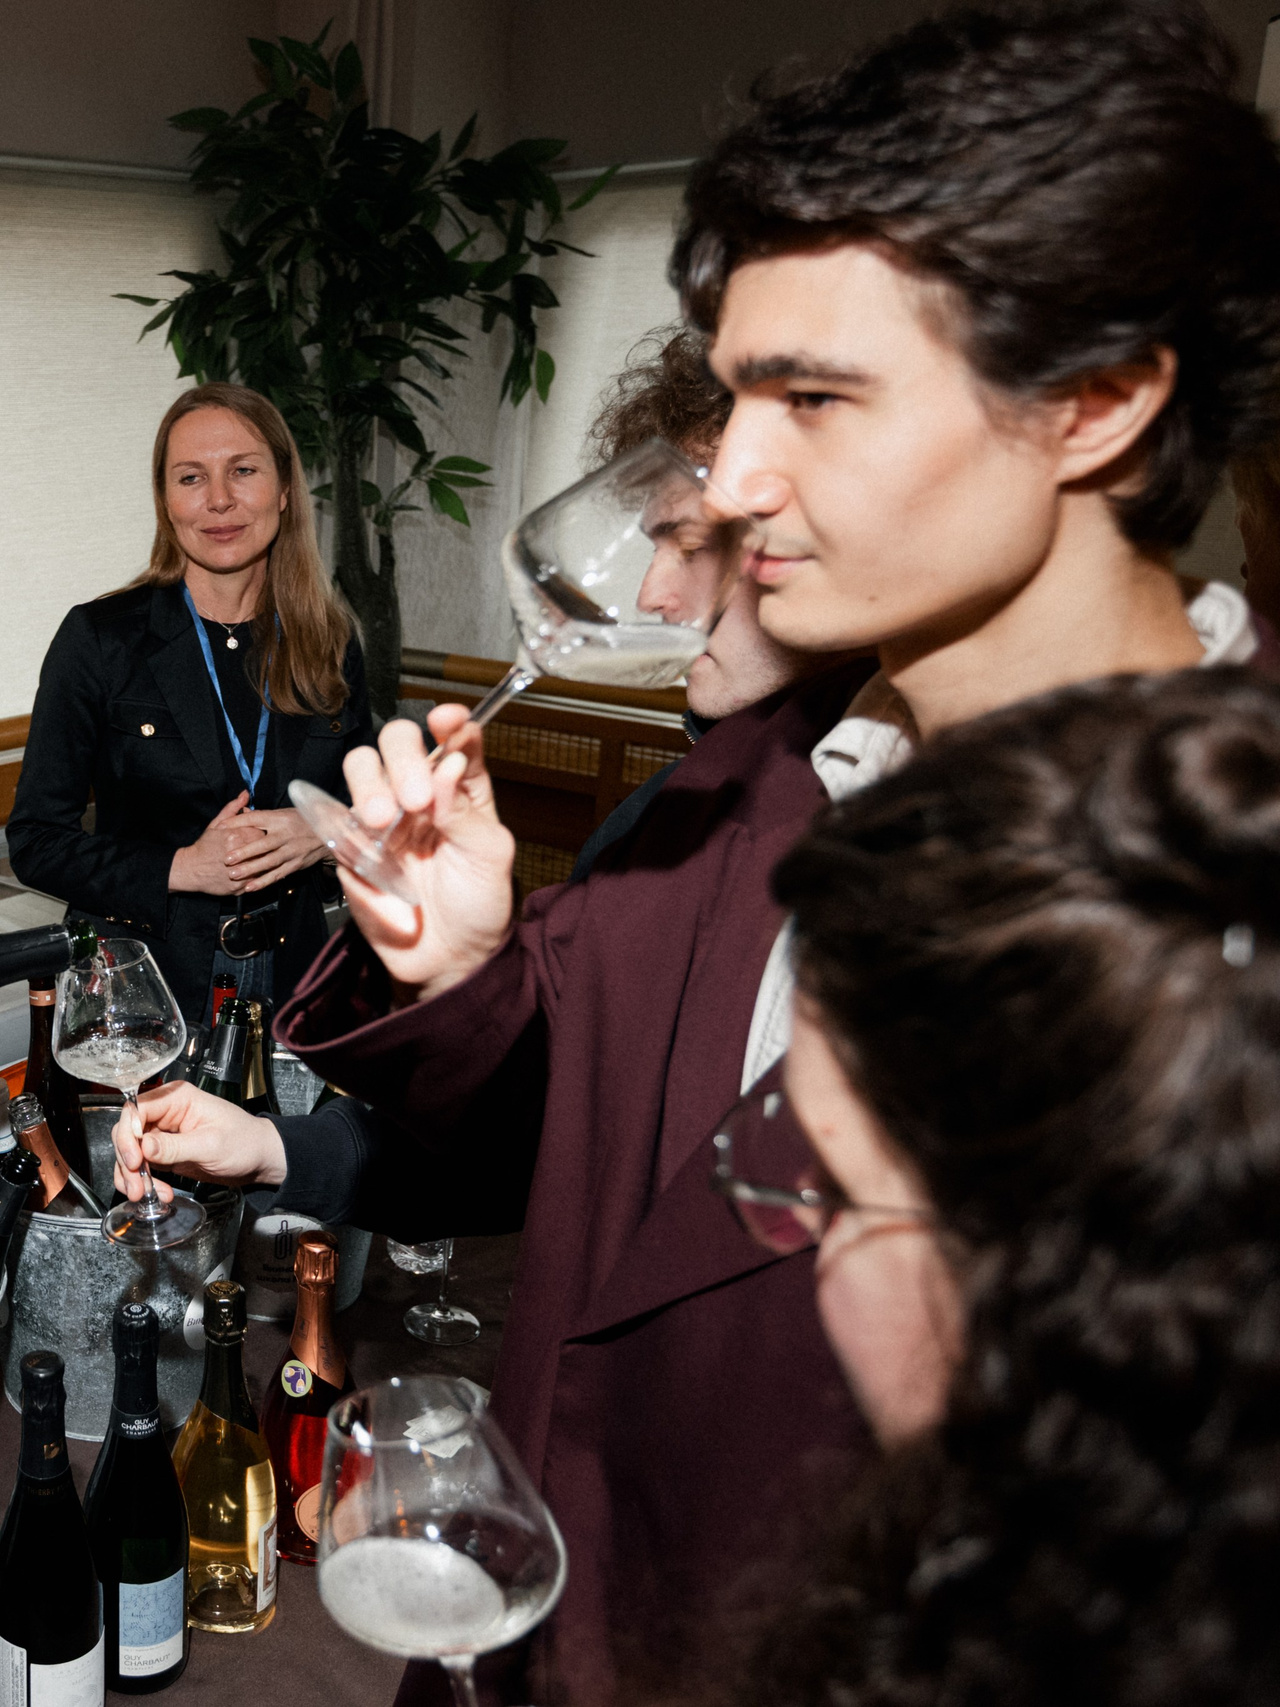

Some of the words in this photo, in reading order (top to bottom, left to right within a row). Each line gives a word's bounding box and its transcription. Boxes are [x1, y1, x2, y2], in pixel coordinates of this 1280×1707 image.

[121, 1417, 159, 1431] CHARBAUT
[134, 1417, 149, 1425] GUY
[126, 1427, 156, 1436] CHAMPAGNE
[124, 1653, 171, 1666] CHARBAUT
